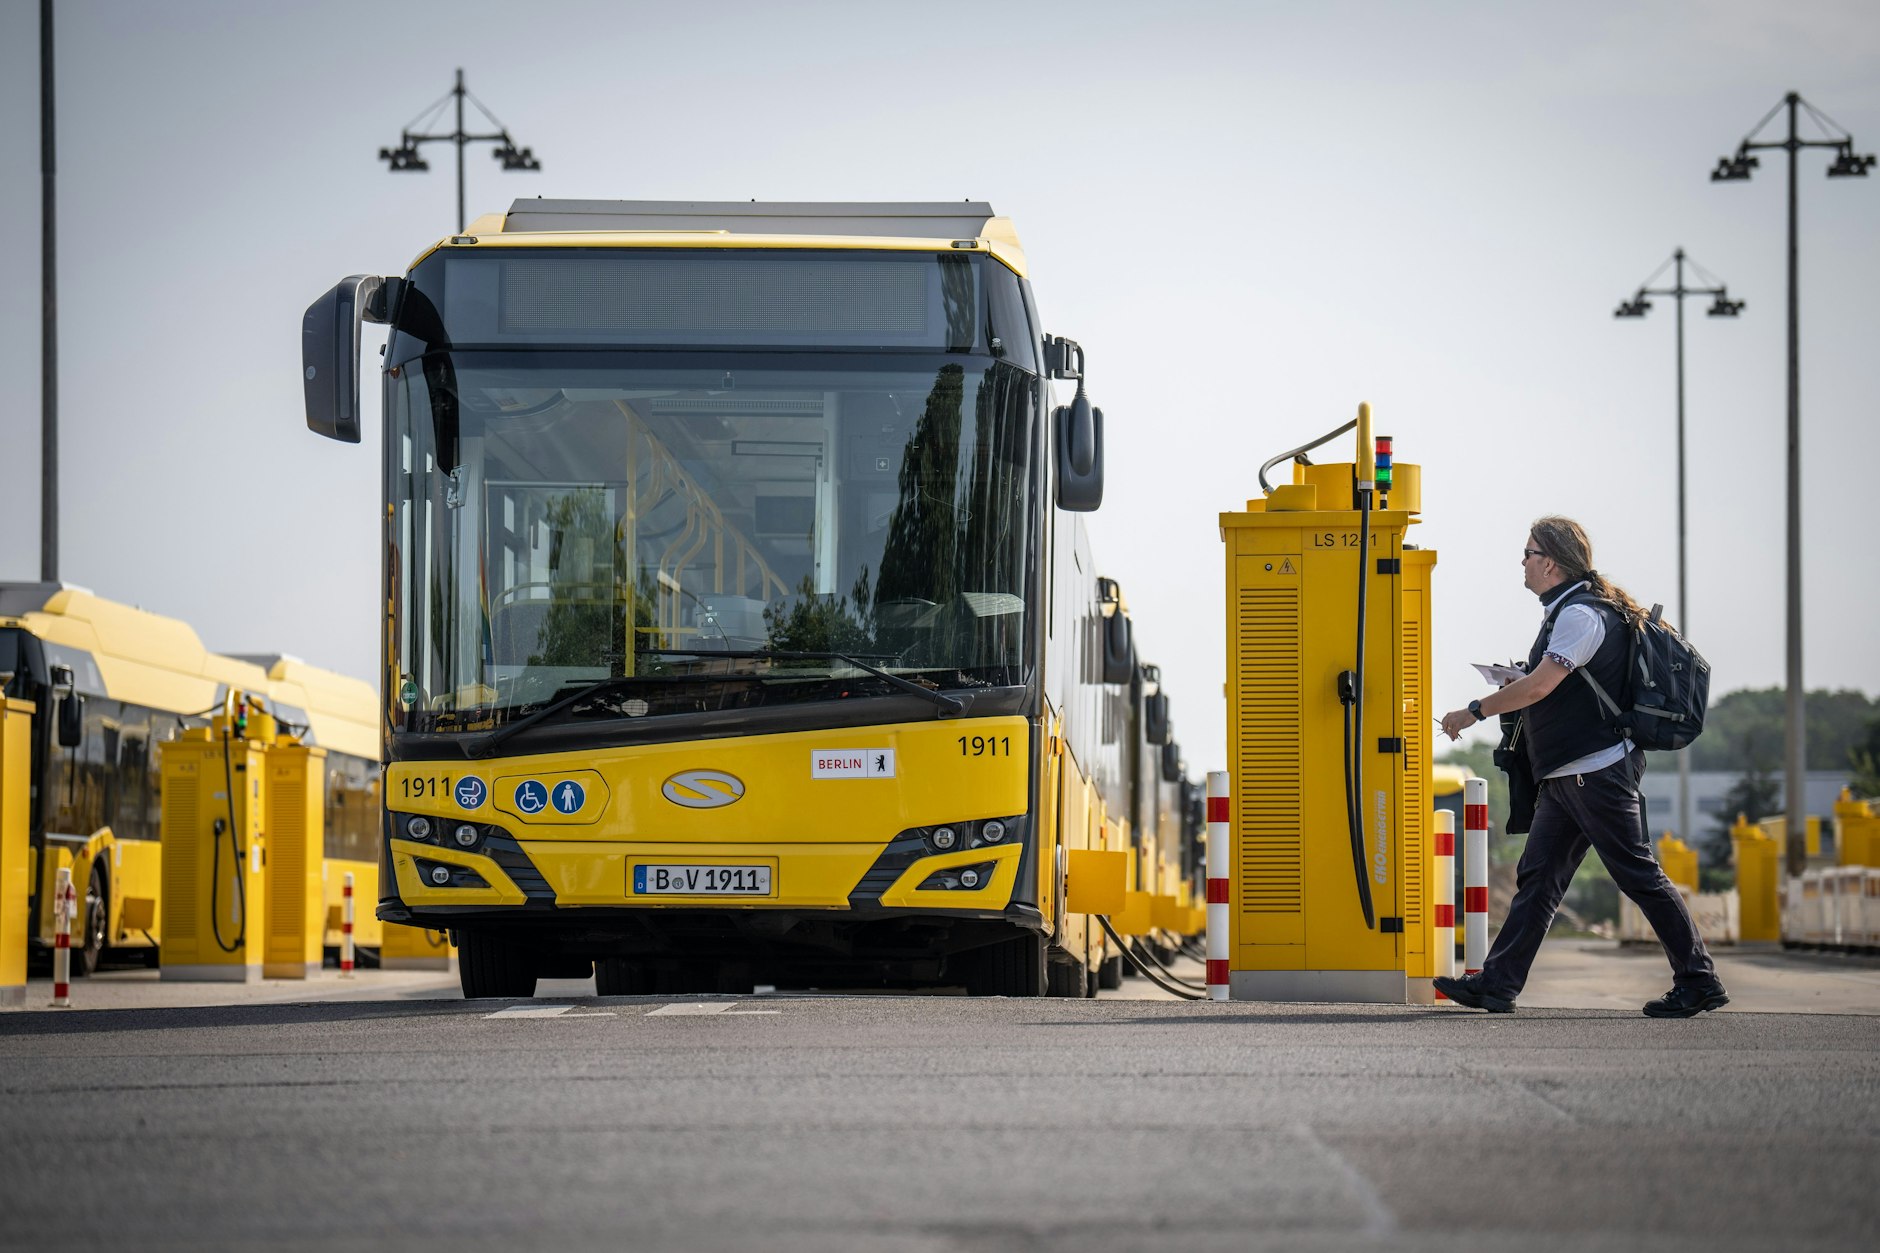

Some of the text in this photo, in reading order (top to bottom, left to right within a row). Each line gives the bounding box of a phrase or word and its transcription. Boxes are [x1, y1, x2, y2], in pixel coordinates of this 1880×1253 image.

[1315, 533, 1376, 547] LS 121
[958, 736, 1010, 757] 1911
[818, 758, 862, 770] BERLIN
[401, 777, 450, 798] 1911
[656, 869, 670, 890] B
[705, 869, 760, 891] 1911
